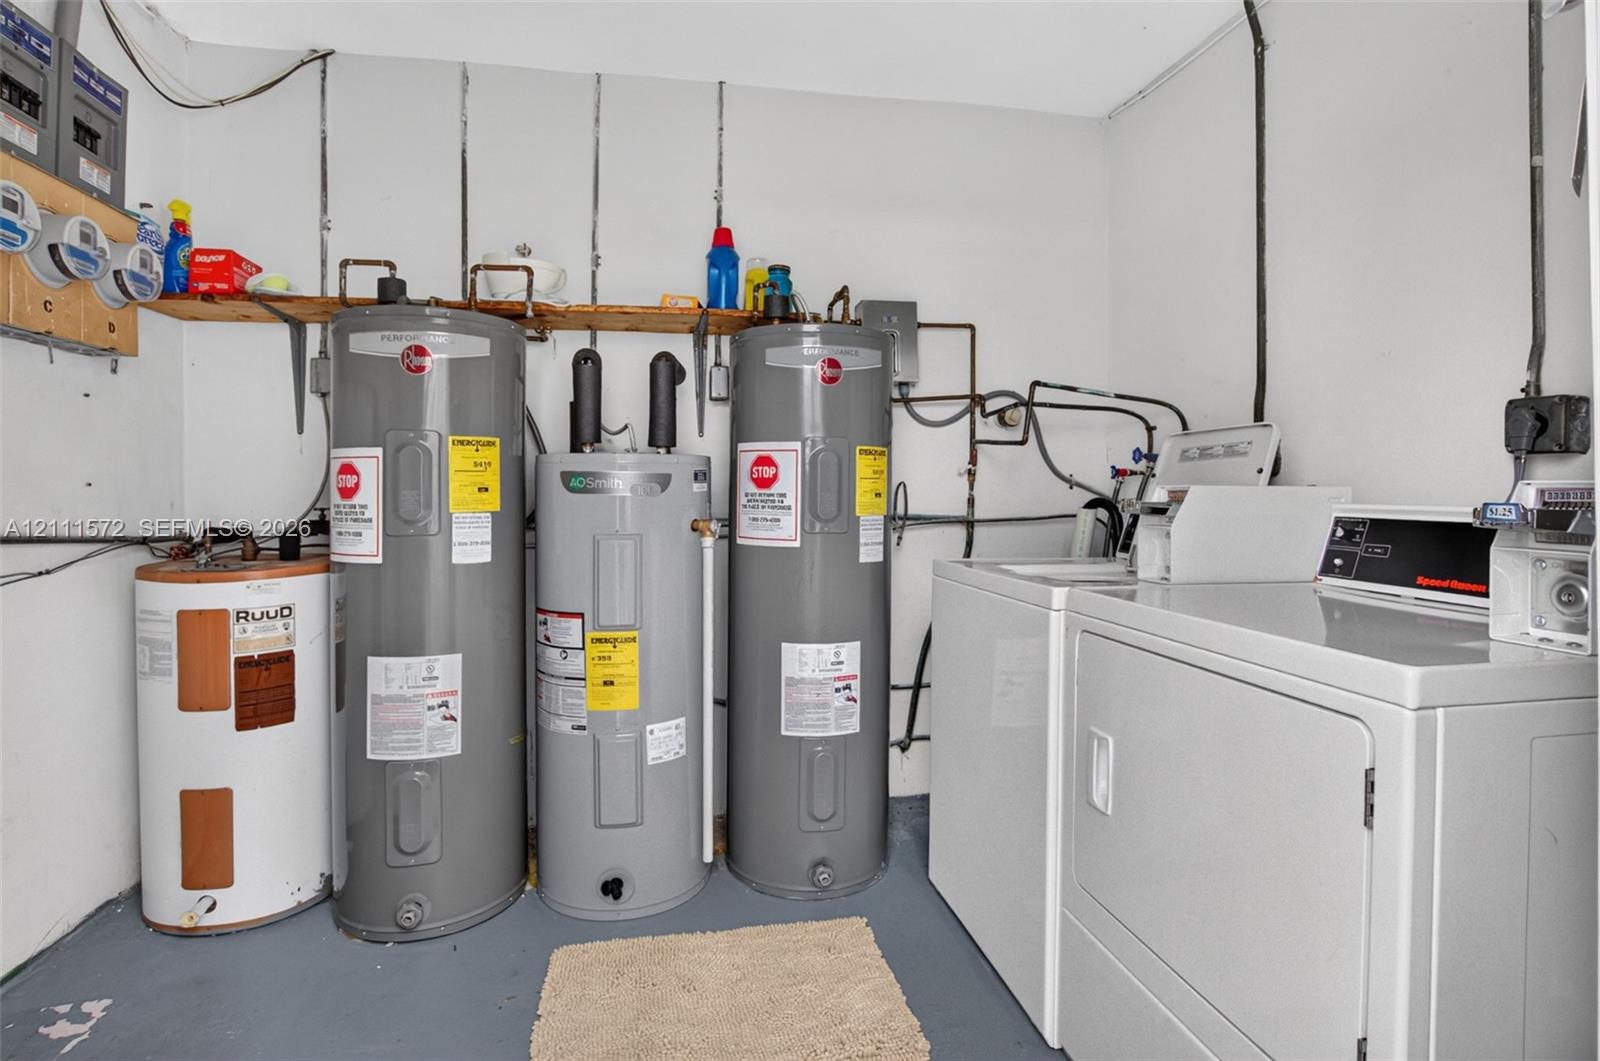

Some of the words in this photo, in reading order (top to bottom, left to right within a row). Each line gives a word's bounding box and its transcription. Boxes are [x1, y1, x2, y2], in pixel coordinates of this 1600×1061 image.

[44, 300, 53, 313] C
[108, 322, 116, 334] D
[380, 333, 454, 345] PERFORANC
[752, 466, 777, 479] STOP
[337, 474, 358, 488] STOP
[1488, 505, 1513, 517] $1.25
[1416, 575, 1450, 588] Speed
[1450, 578, 1487, 593] Queen
[236, 606, 293, 623] RUUD
